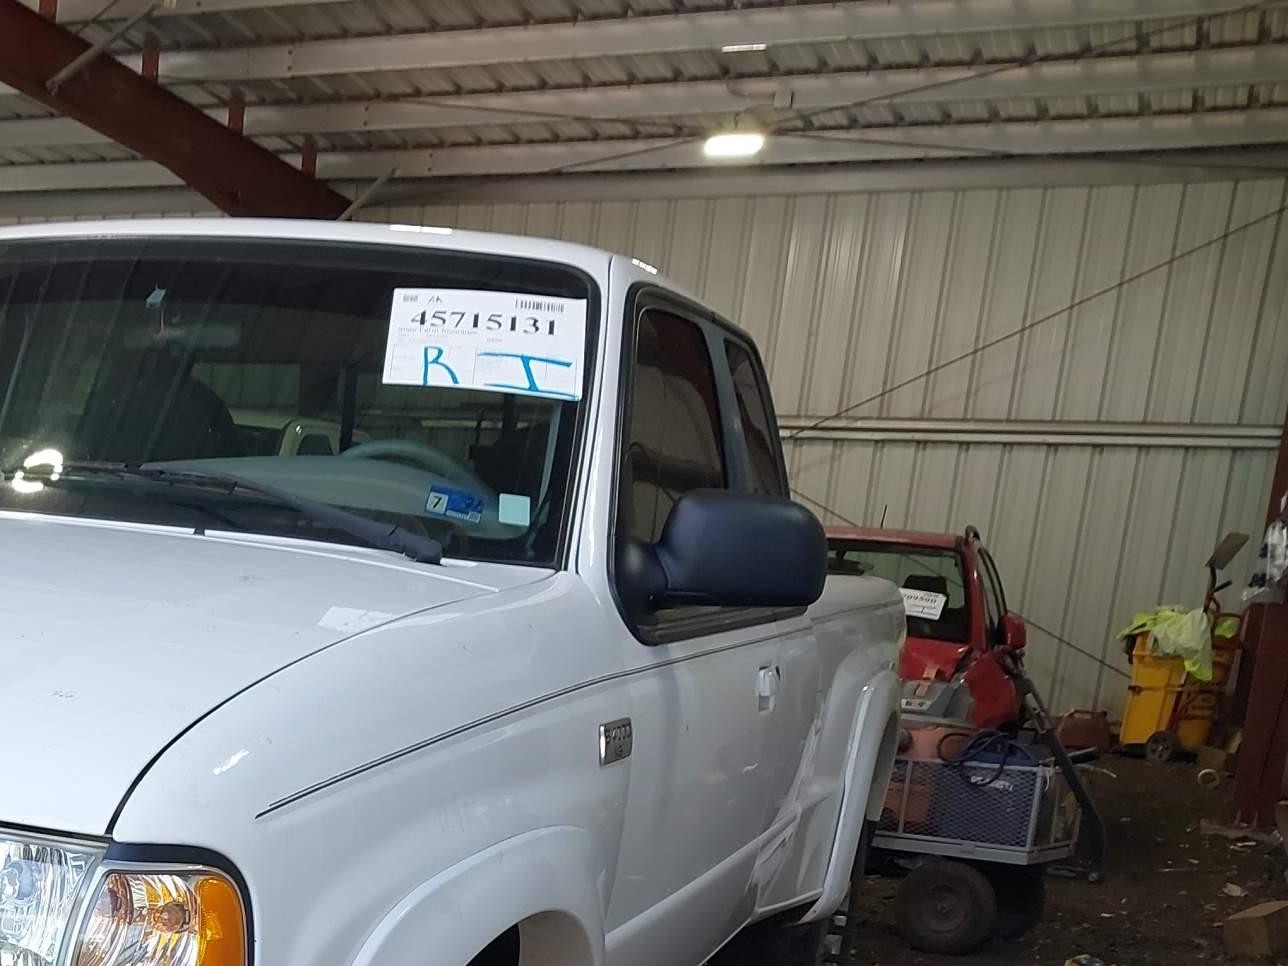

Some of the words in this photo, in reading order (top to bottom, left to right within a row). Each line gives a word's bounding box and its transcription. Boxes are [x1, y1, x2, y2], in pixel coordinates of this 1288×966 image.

[410, 310, 555, 336] 45715131
[423, 346, 459, 386] R
[433, 495, 443, 509] 7
